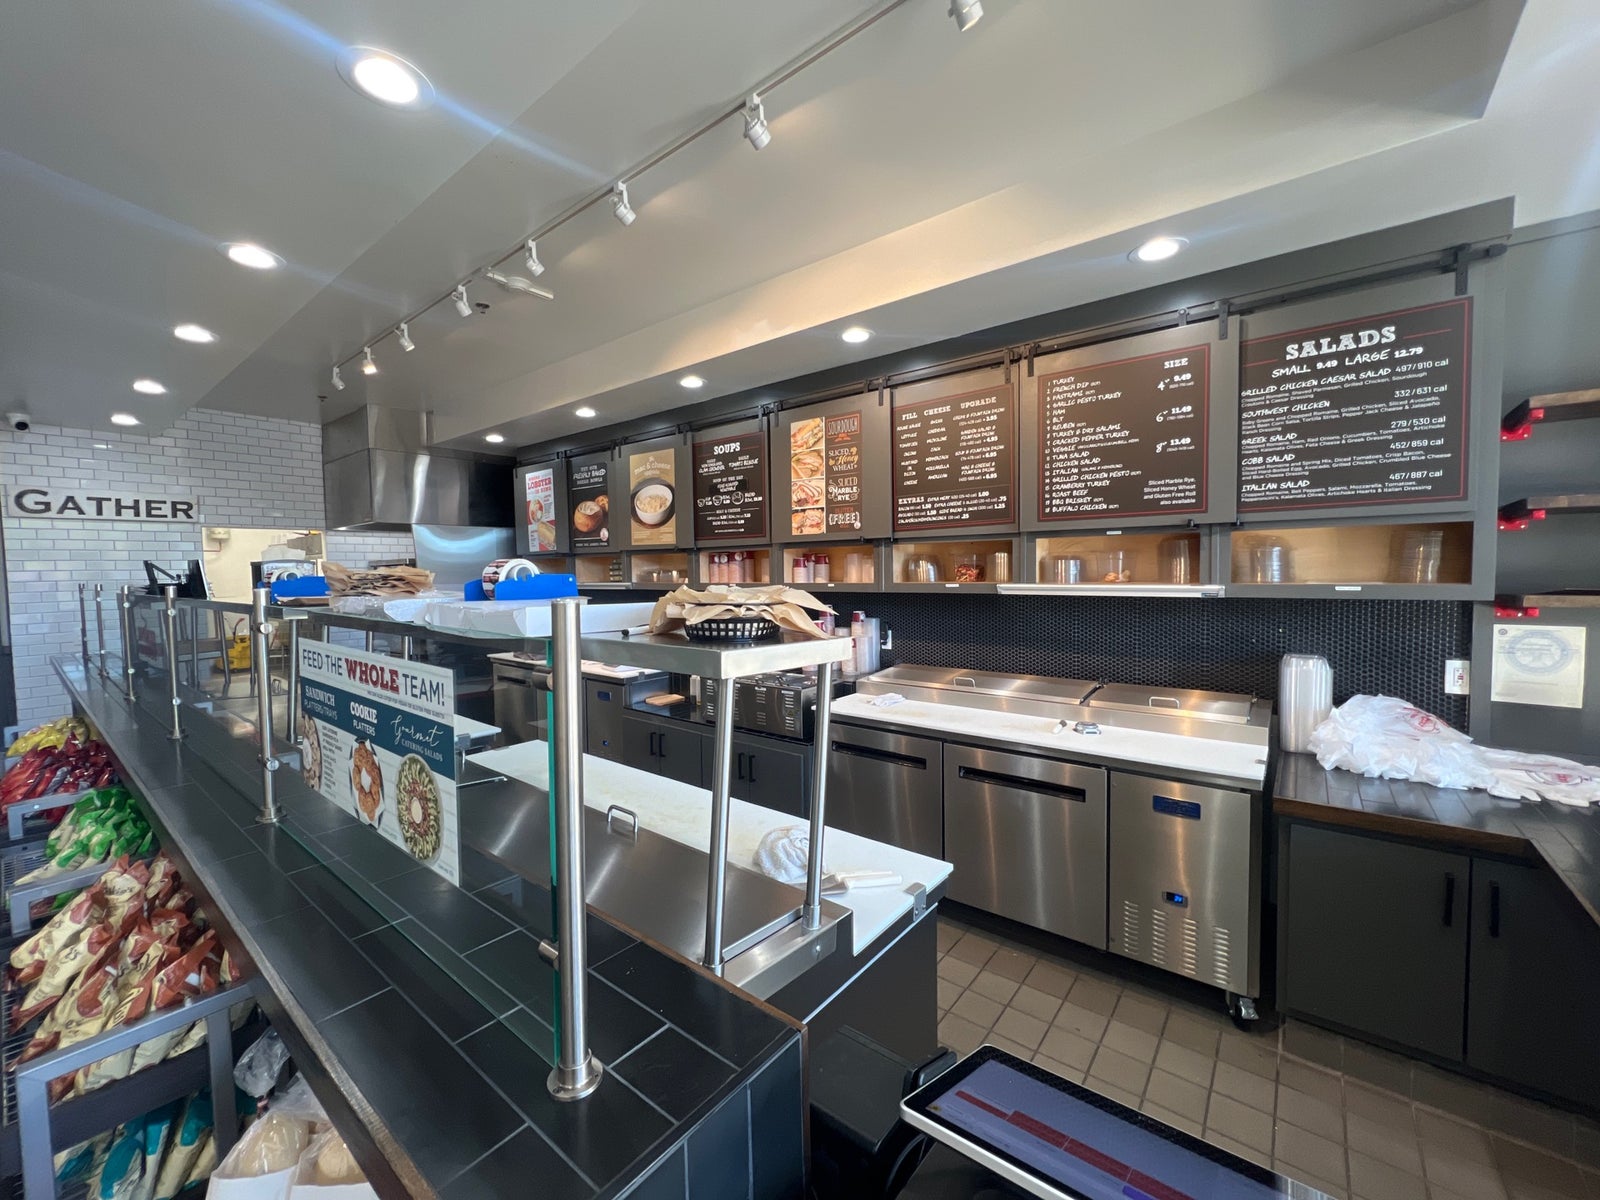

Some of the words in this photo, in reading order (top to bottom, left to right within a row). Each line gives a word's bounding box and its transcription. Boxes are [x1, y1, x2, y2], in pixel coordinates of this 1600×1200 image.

[1286, 326, 1396, 360] SALADS
[1164, 357, 1188, 369] SIZE
[1271, 364, 1311, 378] SMALL
[1316, 359, 1338, 370] 9.49
[1345, 348, 1391, 365] LARGE
[1394, 346, 1424, 358] 12.79
[1052, 376, 1075, 385] TURKEY
[1241, 385, 1277, 397] GRILLED
[1280, 379, 1318, 391] CHICKEN
[1320, 373, 1357, 385] CAESAR
[1359, 368, 1391, 379] SALAD
[1434, 358, 1449, 368] cal
[1052, 383, 1076, 393] FRENCH
[1076, 381, 1089, 389] DIP
[1433, 384, 1448, 393] cal
[1052, 390, 1083, 401] PASTRAMI
[1052, 399, 1076, 408] GARLIC
[1077, 396, 1097, 405] PESTO
[1097, 391, 1122, 400] TURKEY
[960, 396, 997, 409] UPGRADE
[901, 412, 918, 421] FILL
[923, 405, 951, 416] CHEESE
[1241, 406, 1289, 419] SOUTHWEST
[1292, 400, 1330, 412] CHICKEN
[1431, 415, 1446, 423] cal
[828, 418, 857, 435] SOURDOUGH
[1052, 422, 1075, 431] REUBEN
[1052, 429, 1075, 438] TURKEY
[1082, 427, 1095, 435] DRY
[1095, 423, 1122, 432] SALAMI
[1052, 436, 1080, 446] CRACKED
[1081, 433, 1104, 442] PEPPER
[1105, 430, 1130, 439] TURKEY
[1241, 436, 1268, 445] GREEK
[1269, 432, 1298, 442] SALAD
[1429, 437, 1444, 446] cal
[713, 442, 741, 455] SOUPS
[835, 454, 859, 466] Honey
[1052, 453, 1068, 461] TUNA
[1069, 451, 1090, 459] SALAD
[1241, 456, 1264, 465] COBB
[1265, 453, 1295, 463] SALAD
[832, 464, 854, 472] WHEAT
[1052, 459, 1079, 468] CHICKEN
[1079, 457, 1101, 465] SALAD
[1052, 467, 1079, 476] ITALIAN
[1052, 475, 1079, 483] GRILLED
[1108, 470, 1130, 478] PESTO
[1428, 469, 1443, 478] cal
[527, 477, 551, 490] LOBSTER
[837, 476, 858, 487] SLICED
[1241, 482, 1278, 492] ITALIAN
[1280, 480, 1310, 489] SALAD
[837, 494, 851, 502] RYE
[898, 496, 924, 505] EXTRAS
[1079, 503, 1107, 511] CHICKEN
[302, 649, 323, 669] FEED
[325, 654, 343, 676] THE
[344, 657, 400, 694] WHOLE
[402, 673, 445, 707] TEAM!
[305, 685, 335, 707] SANDWICH
[350, 701, 378, 724] COOKIE
[353, 719, 376, 737] PLATTERS
[390, 714, 443, 747] Gourmet
[425, 746, 443, 763] SALADS
